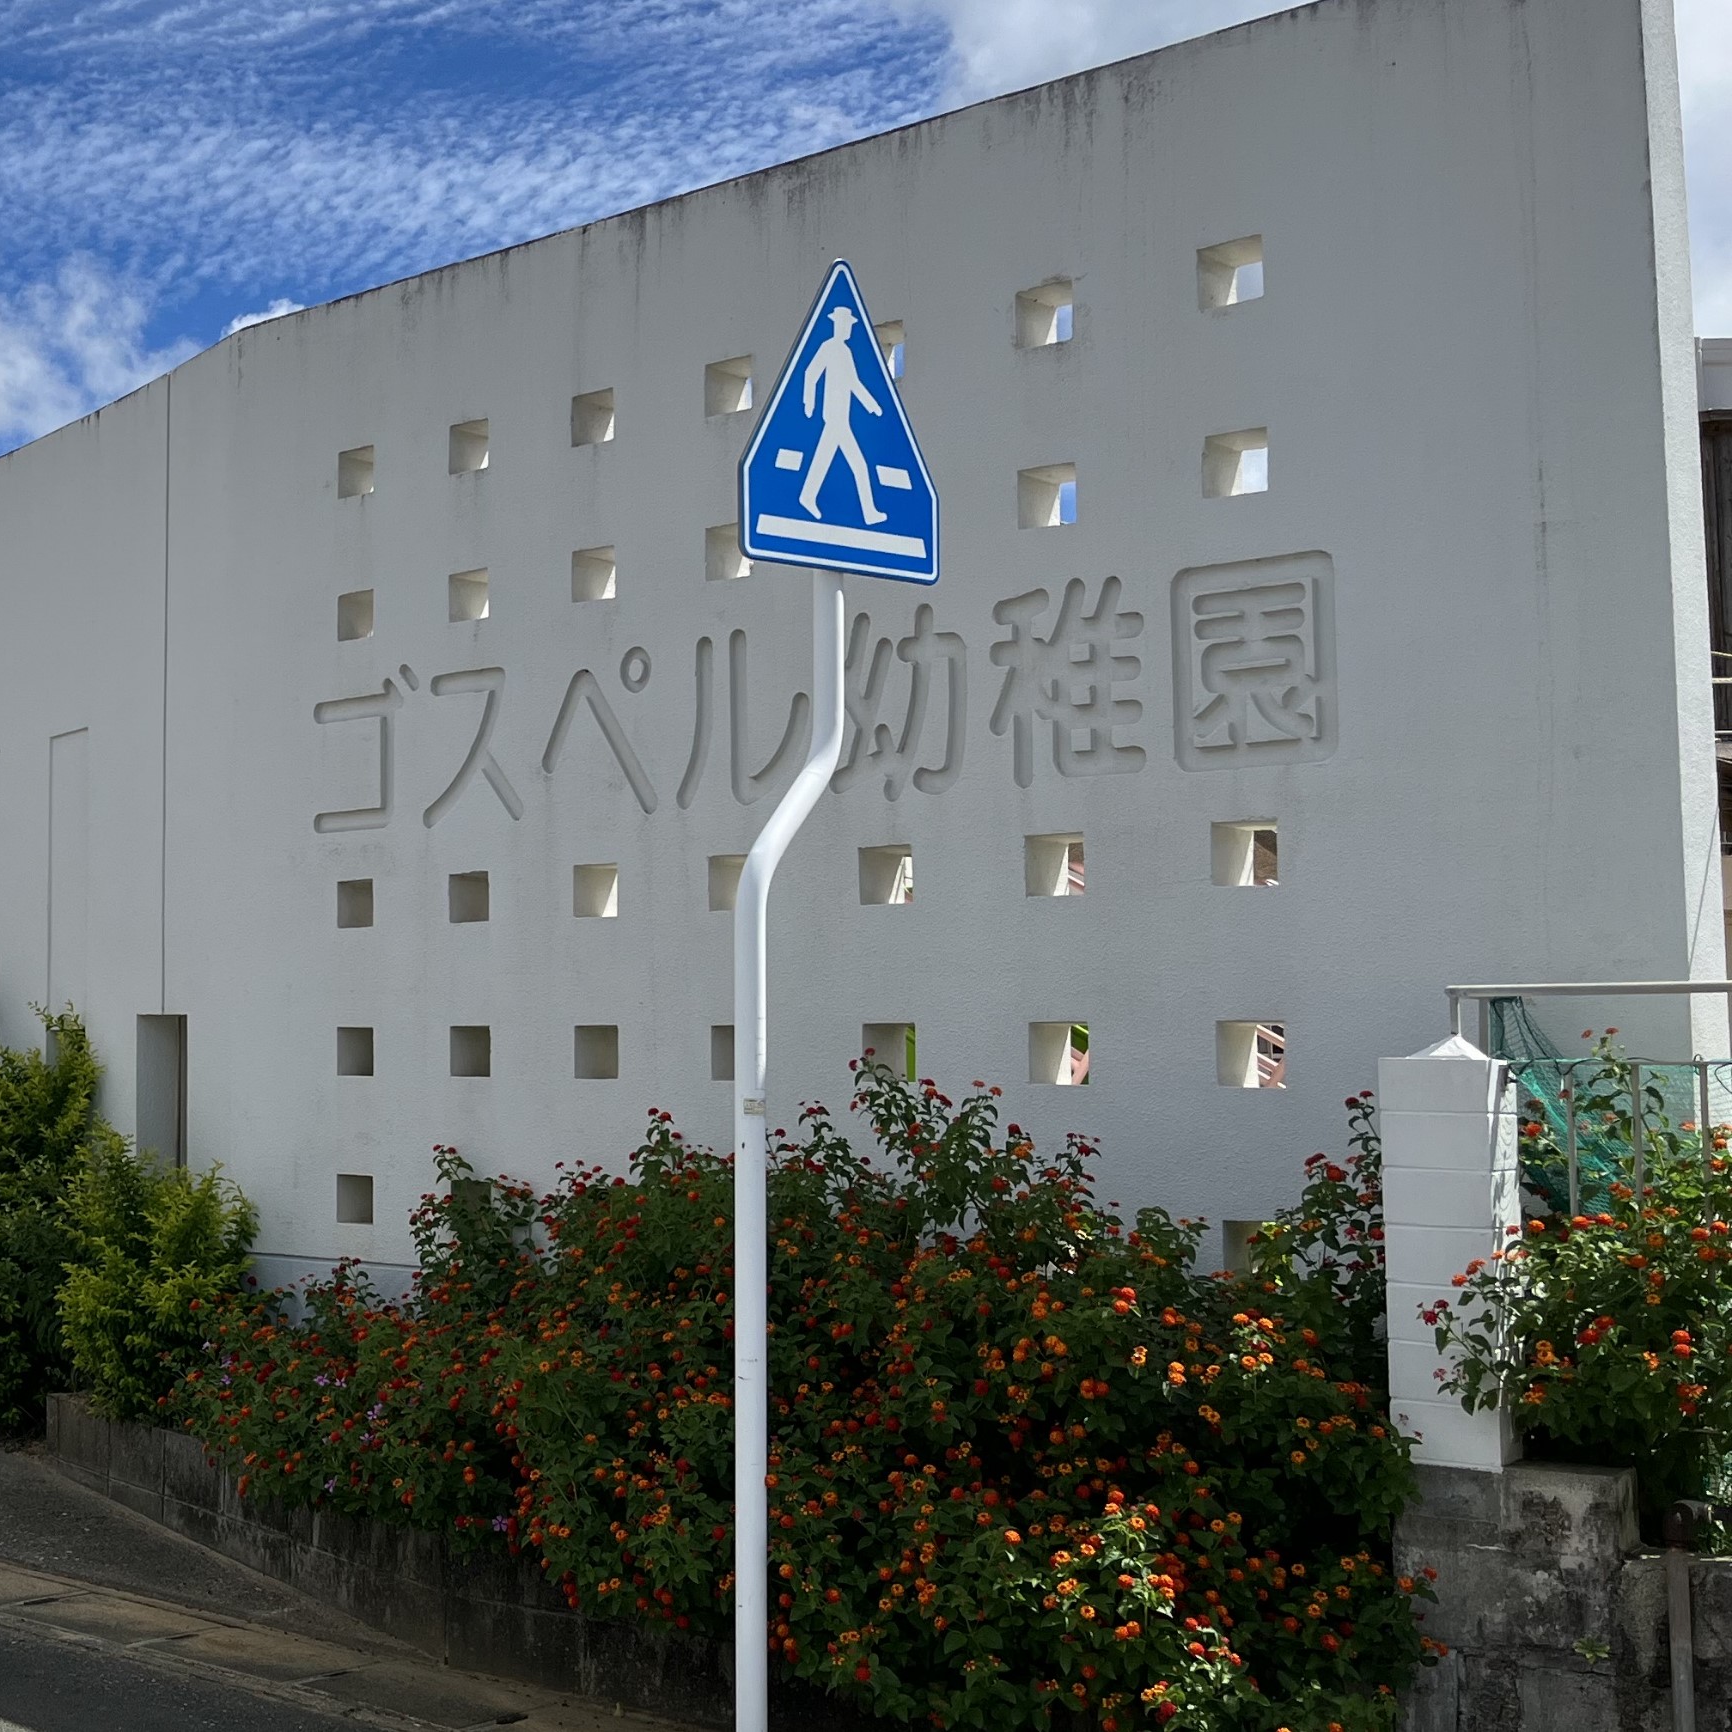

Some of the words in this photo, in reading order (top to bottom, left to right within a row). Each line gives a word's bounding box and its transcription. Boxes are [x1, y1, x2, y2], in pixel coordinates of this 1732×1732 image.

[312, 548, 1340, 835] ゴスペル幼稚園
